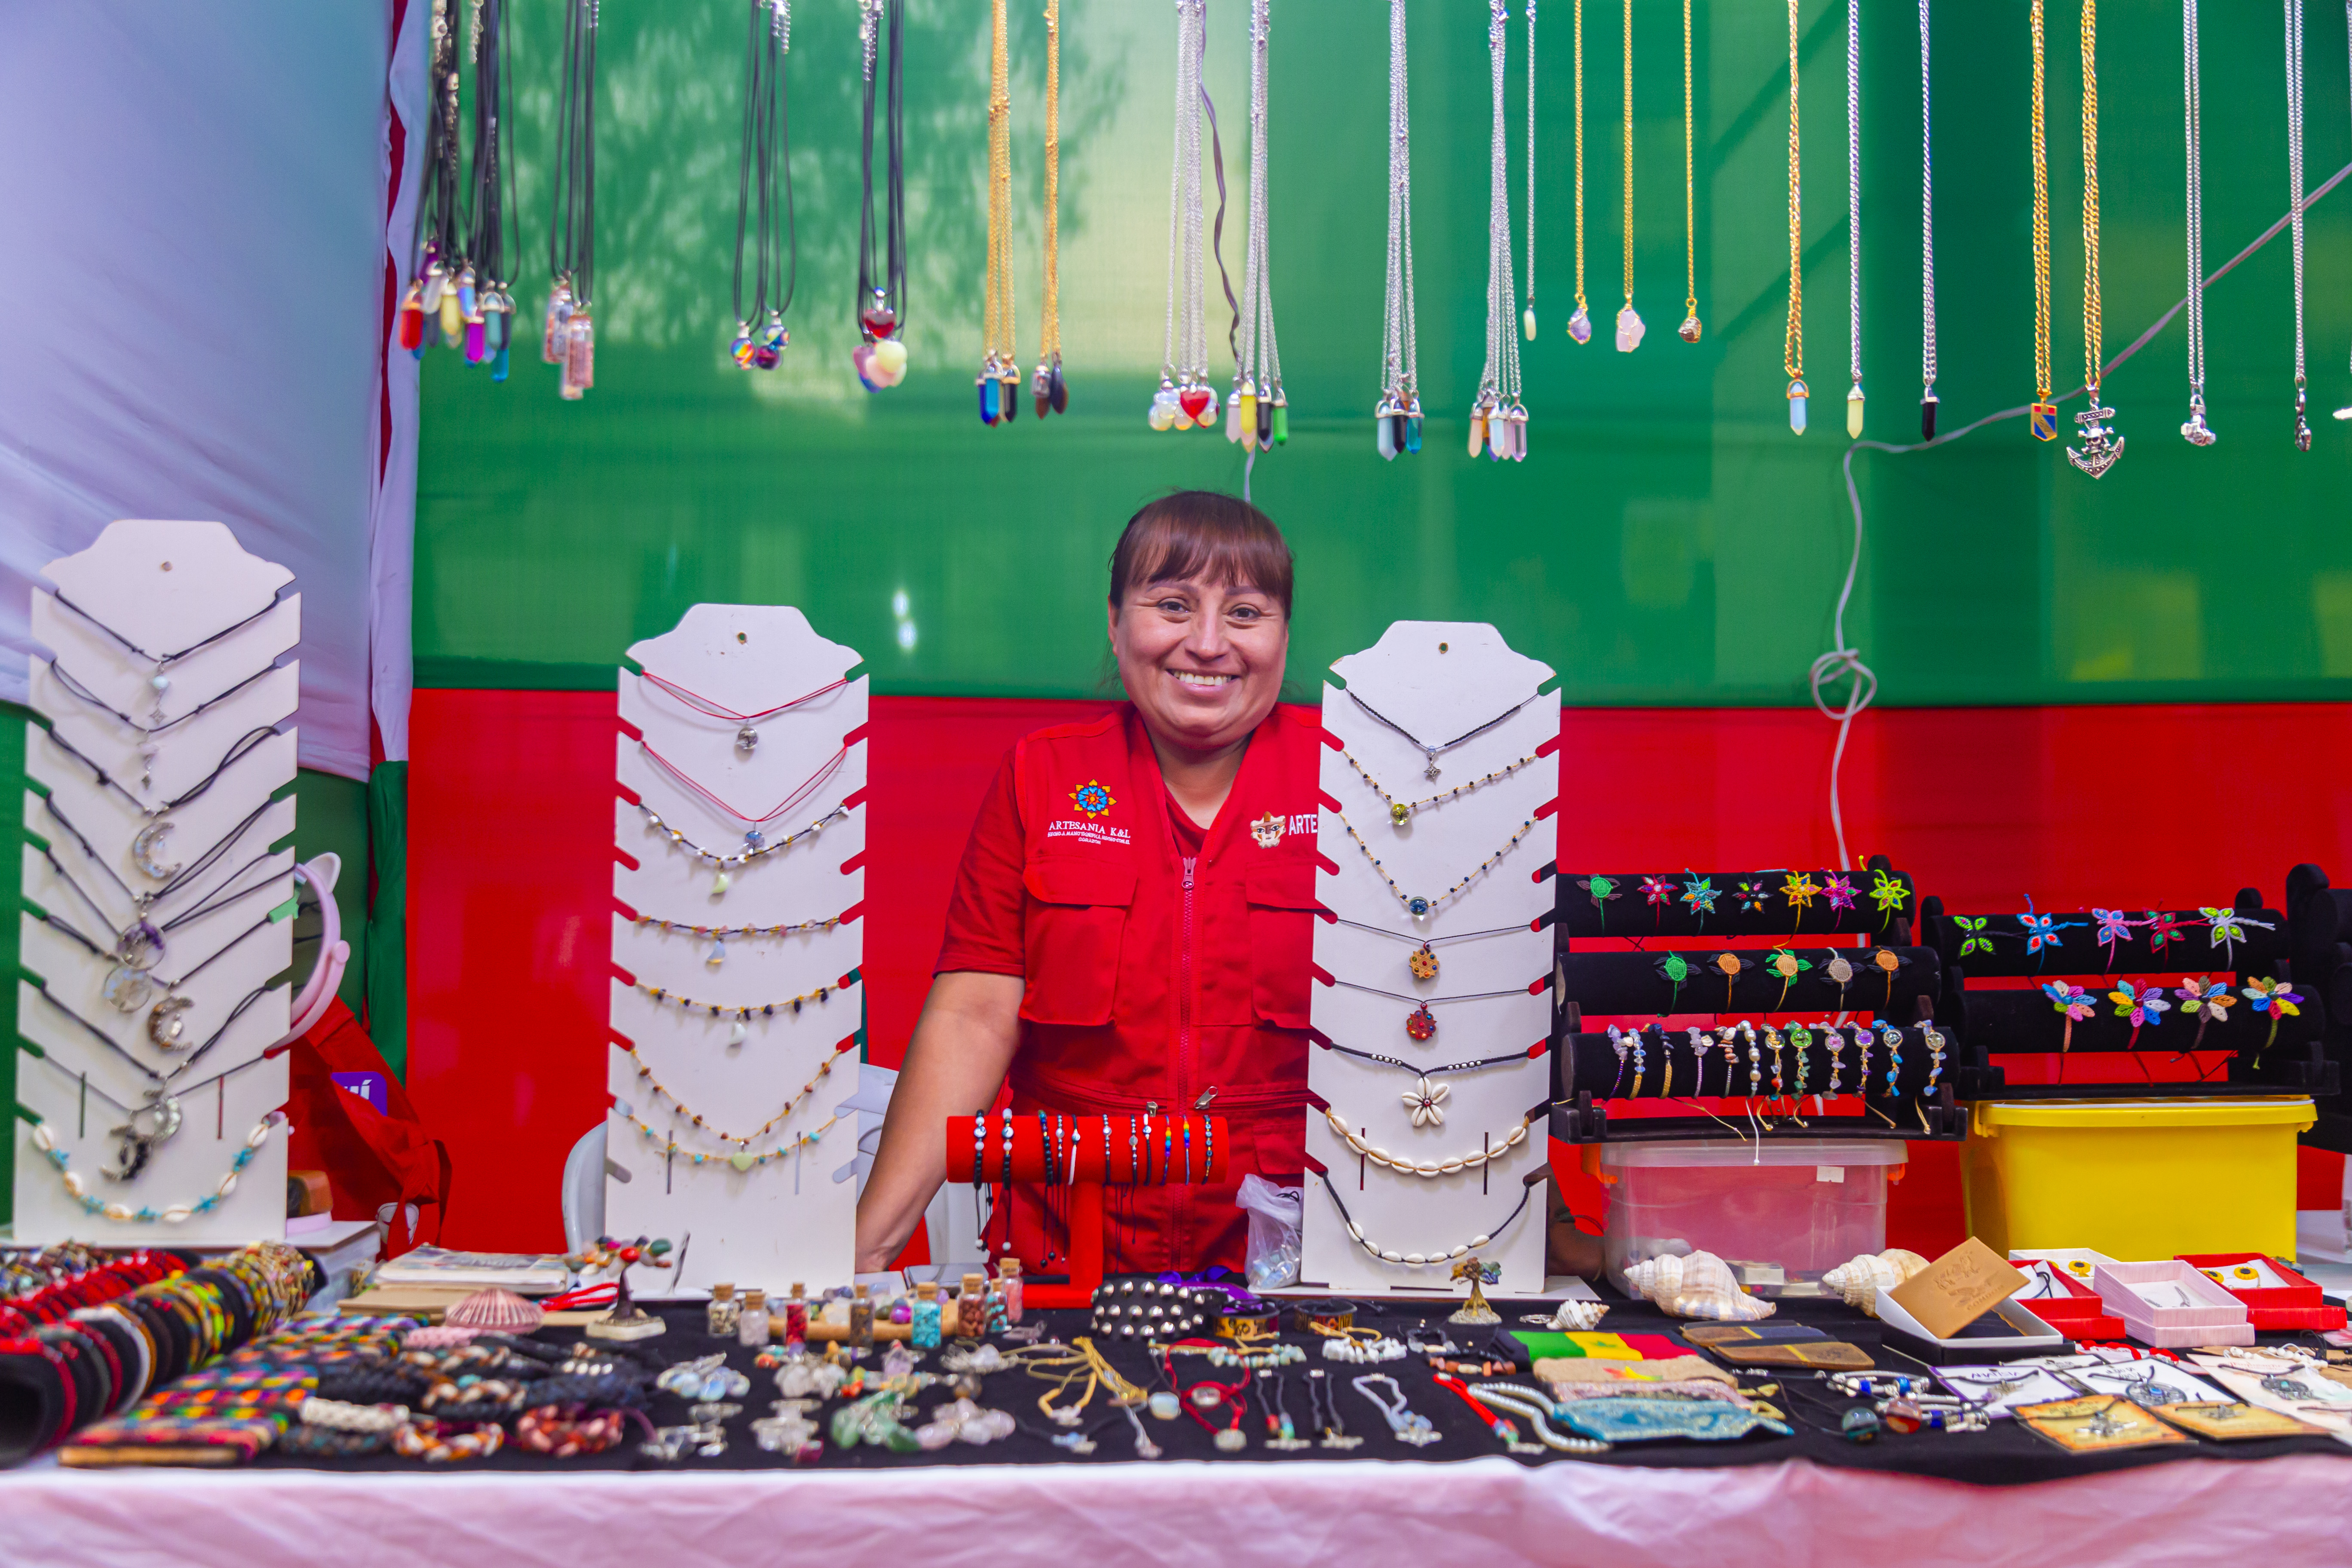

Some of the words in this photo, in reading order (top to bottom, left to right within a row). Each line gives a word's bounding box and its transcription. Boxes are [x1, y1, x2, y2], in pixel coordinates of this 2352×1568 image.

[1049, 821, 1106, 834] ARTESANIA
[1110, 827, 1130, 838] K&L
[1289, 814, 1319, 836] ARTE
